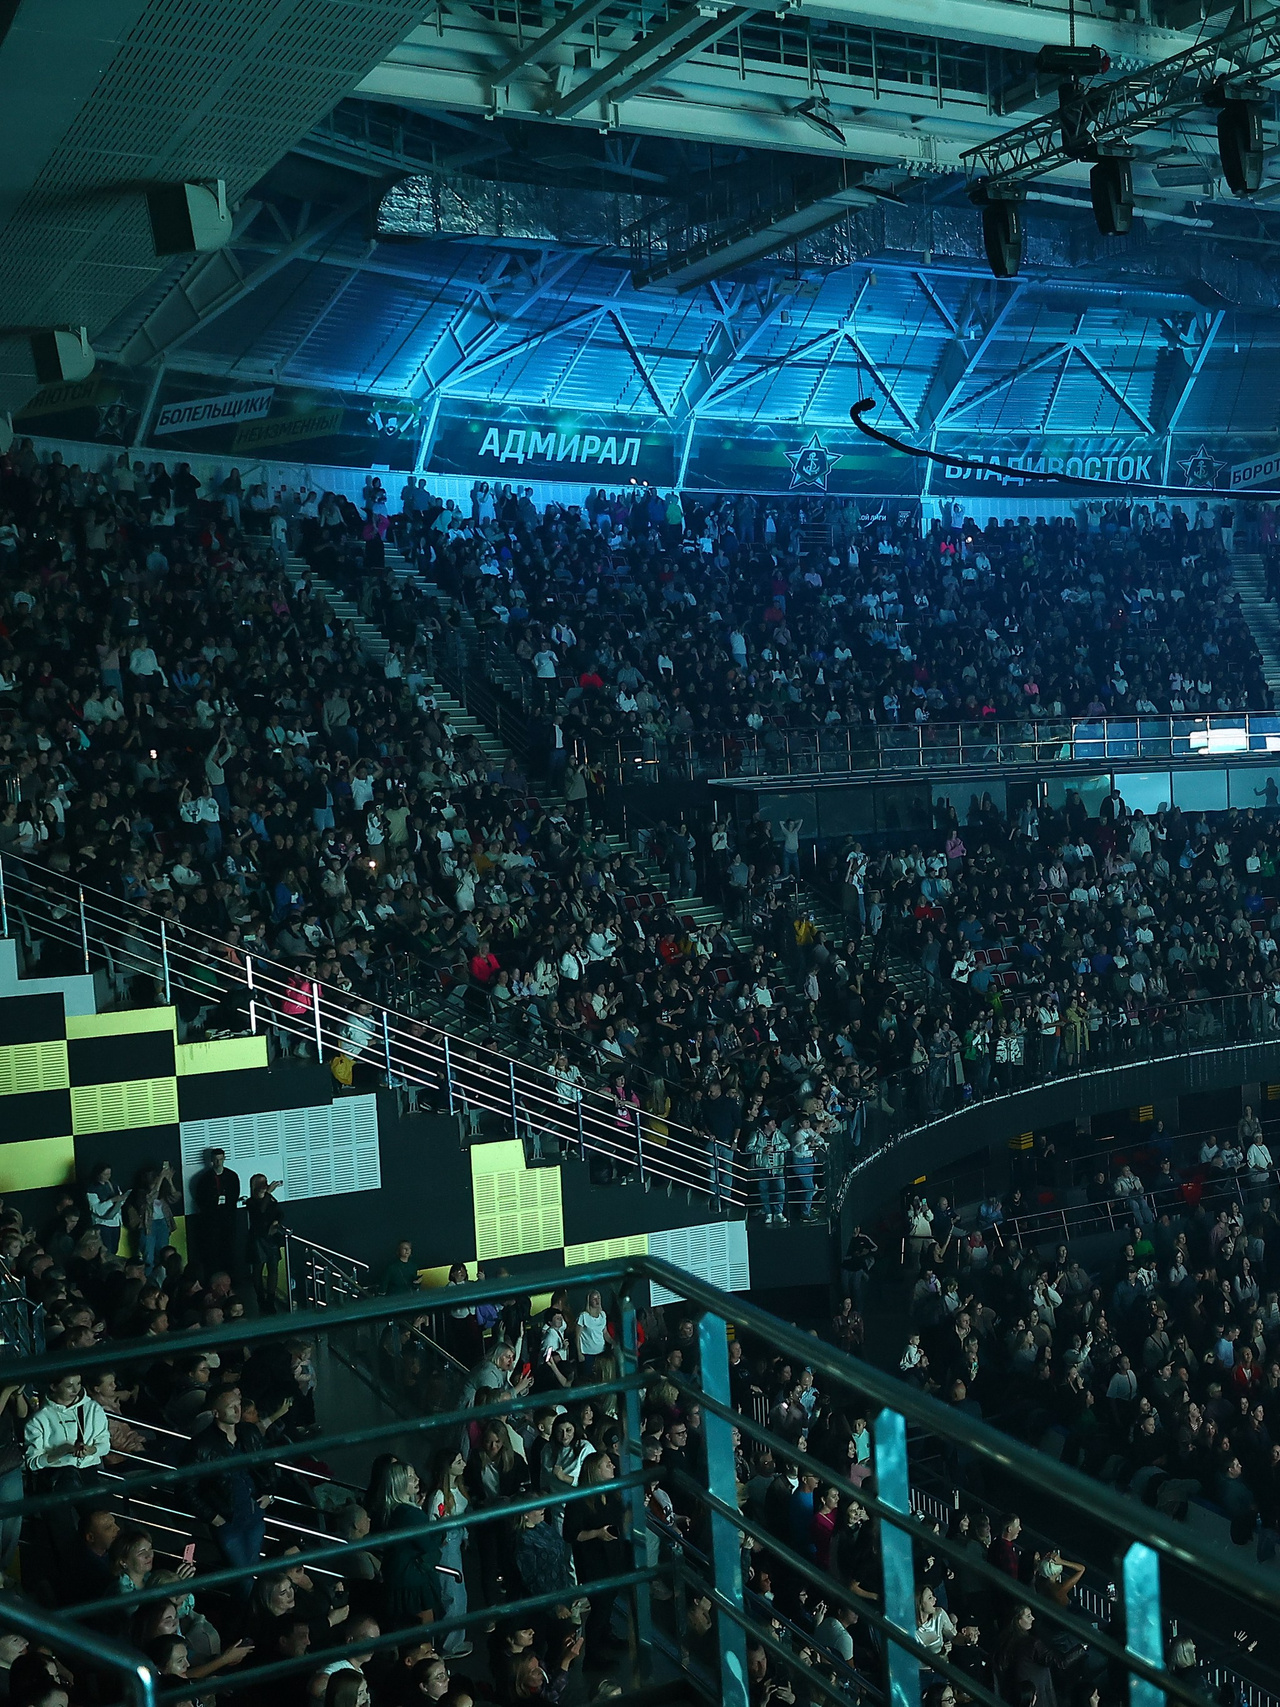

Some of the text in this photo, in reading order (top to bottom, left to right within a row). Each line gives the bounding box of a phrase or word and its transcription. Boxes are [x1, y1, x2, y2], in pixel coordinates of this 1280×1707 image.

[28, 380, 95, 409] ЯЮТСЯ
[158, 395, 272, 427] БОЛЕЛЬЩИКИ
[478, 427, 642, 467] АДМИРАЛ
